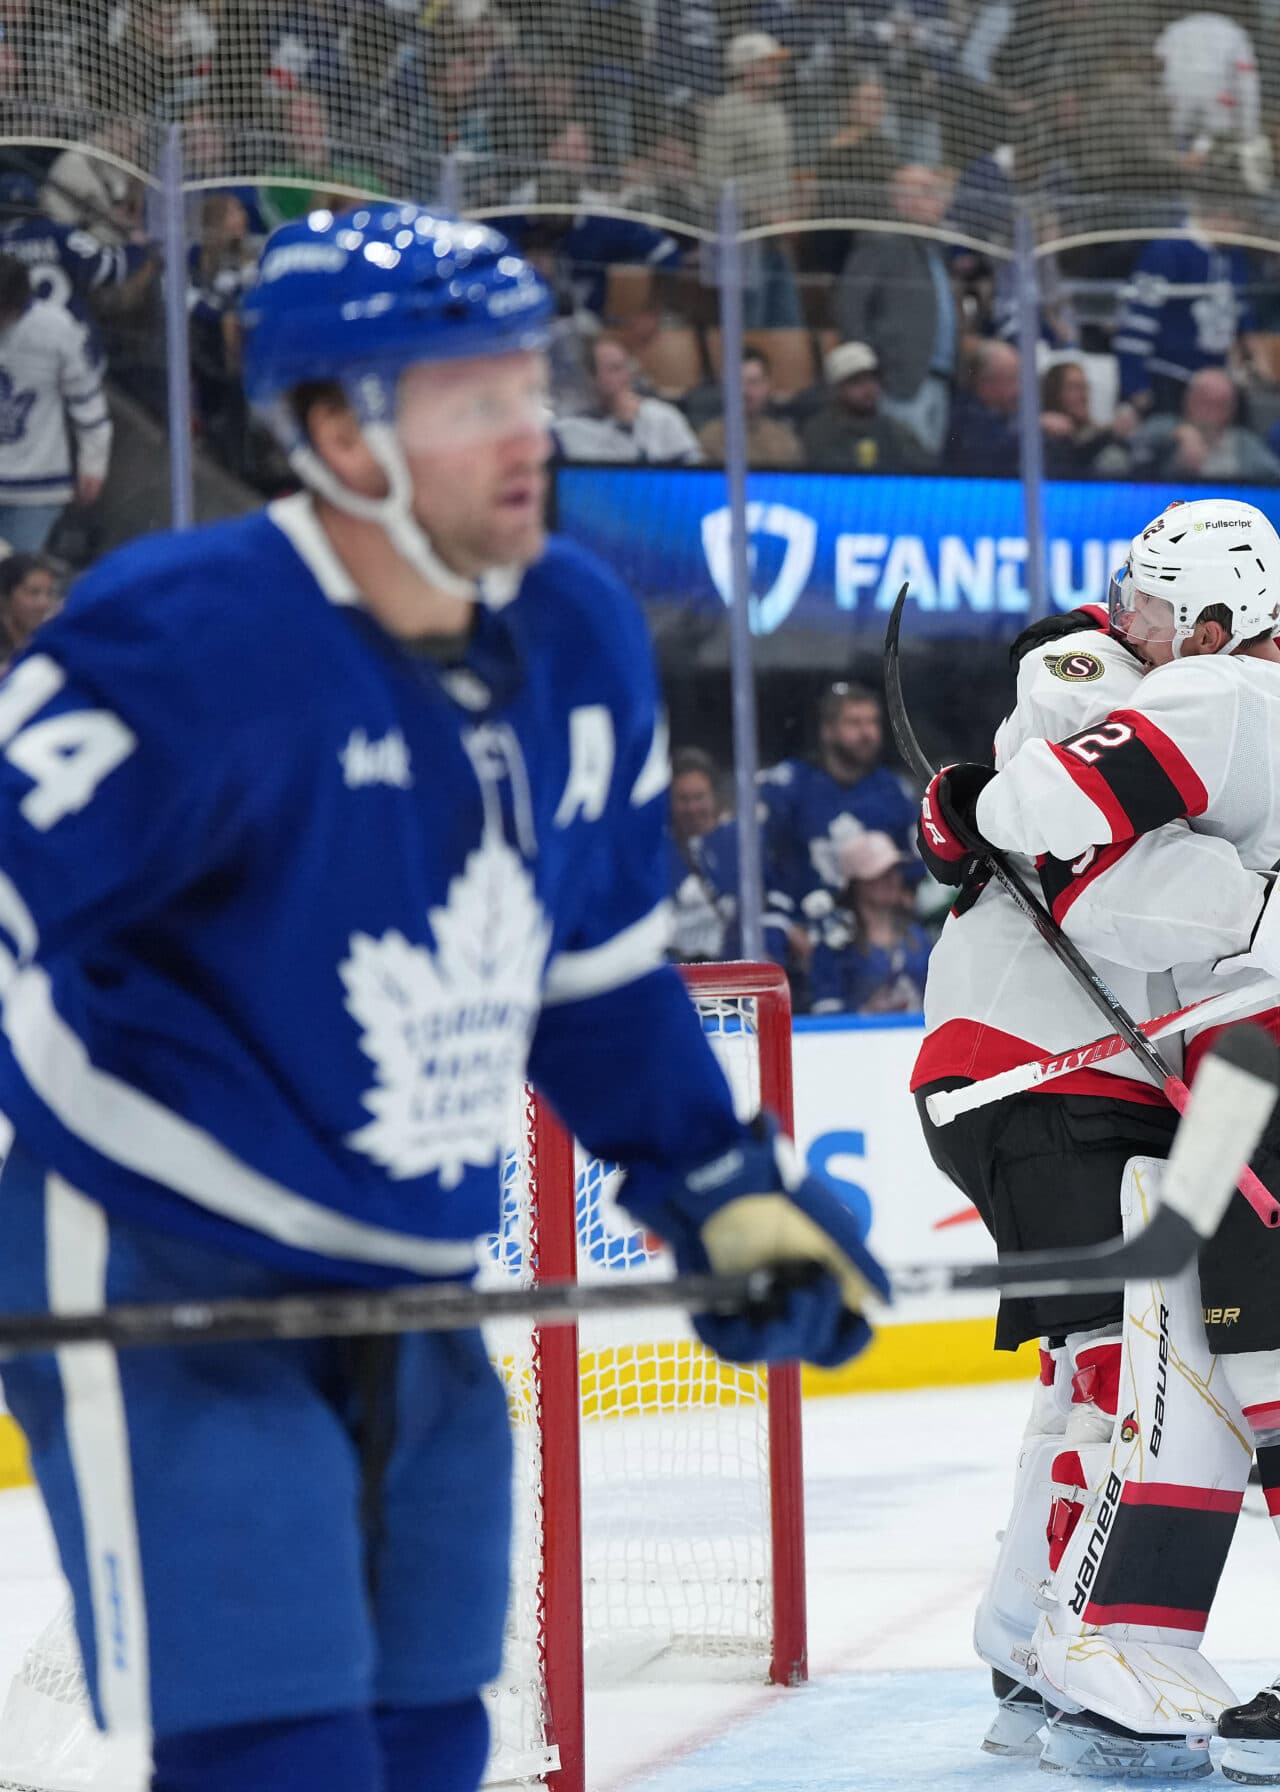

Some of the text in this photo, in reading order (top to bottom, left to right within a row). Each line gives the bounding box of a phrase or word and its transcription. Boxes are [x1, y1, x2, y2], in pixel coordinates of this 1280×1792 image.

[1205, 519, 1253, 530] Fullscript
[1150, 1303, 1170, 1459] BAUER
[1068, 1471, 1122, 1616] BAUER
